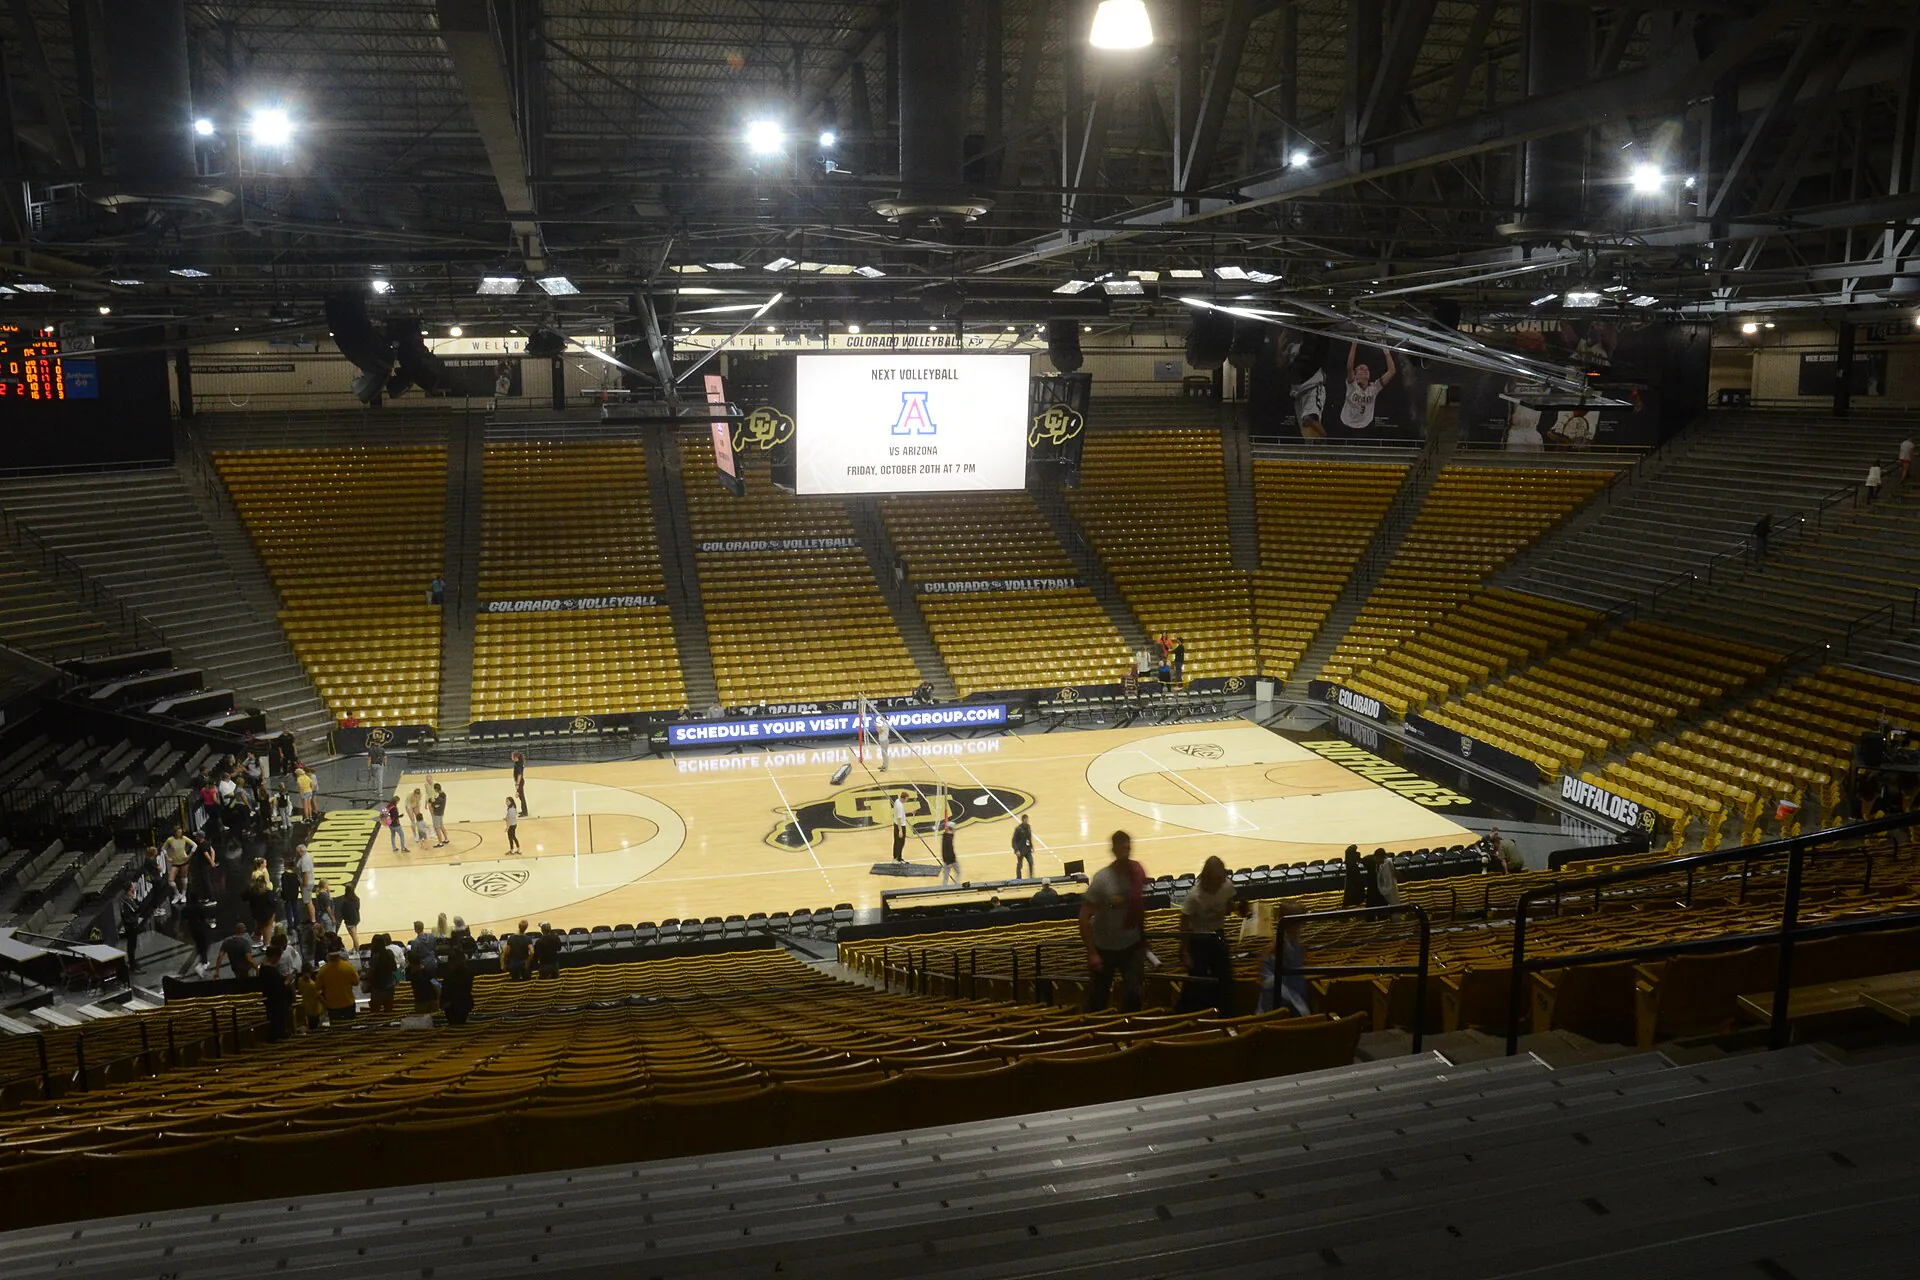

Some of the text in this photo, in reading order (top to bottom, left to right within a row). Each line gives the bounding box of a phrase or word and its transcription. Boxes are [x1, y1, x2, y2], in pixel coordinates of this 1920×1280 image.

[711, 338, 764, 347] CENTER
[846, 336, 962, 348] COLORADO VOLLEYBALL
[10, 362, 18, 374] 0
[26, 366, 37, 374] 07
[55, 366, 61, 374] 0
[27, 374, 38, 382] 09
[871, 369, 959, 380] NEXT VOLLEYBALL
[17, 383, 24, 395] 2
[31, 382, 39, 390] 10
[889, 446, 938, 456] VS ARIZONA
[847, 463, 976, 476] FRIDAY, OCTOBER 20TH AT 7 PM
[703, 538, 855, 552] COLORADO VOLLEYBALL
[924, 578, 1075, 593] COLORADO VOLLEYBALL
[489, 596, 657, 612] COLORADO VOLLEYBALL
[1338, 688, 1380, 719] COLORADO
[676, 723, 759, 740] SCHEDULE
[762, 720, 806, 734] YOUR
[809, 718, 849, 731] VISIT
[852, 717, 872, 728] AT
[875, 708, 1000, 727] SWDGROUP.COM
[1299, 740, 1473, 806] BUFFALOES
[1562, 775, 1639, 826] BUFFALOES
